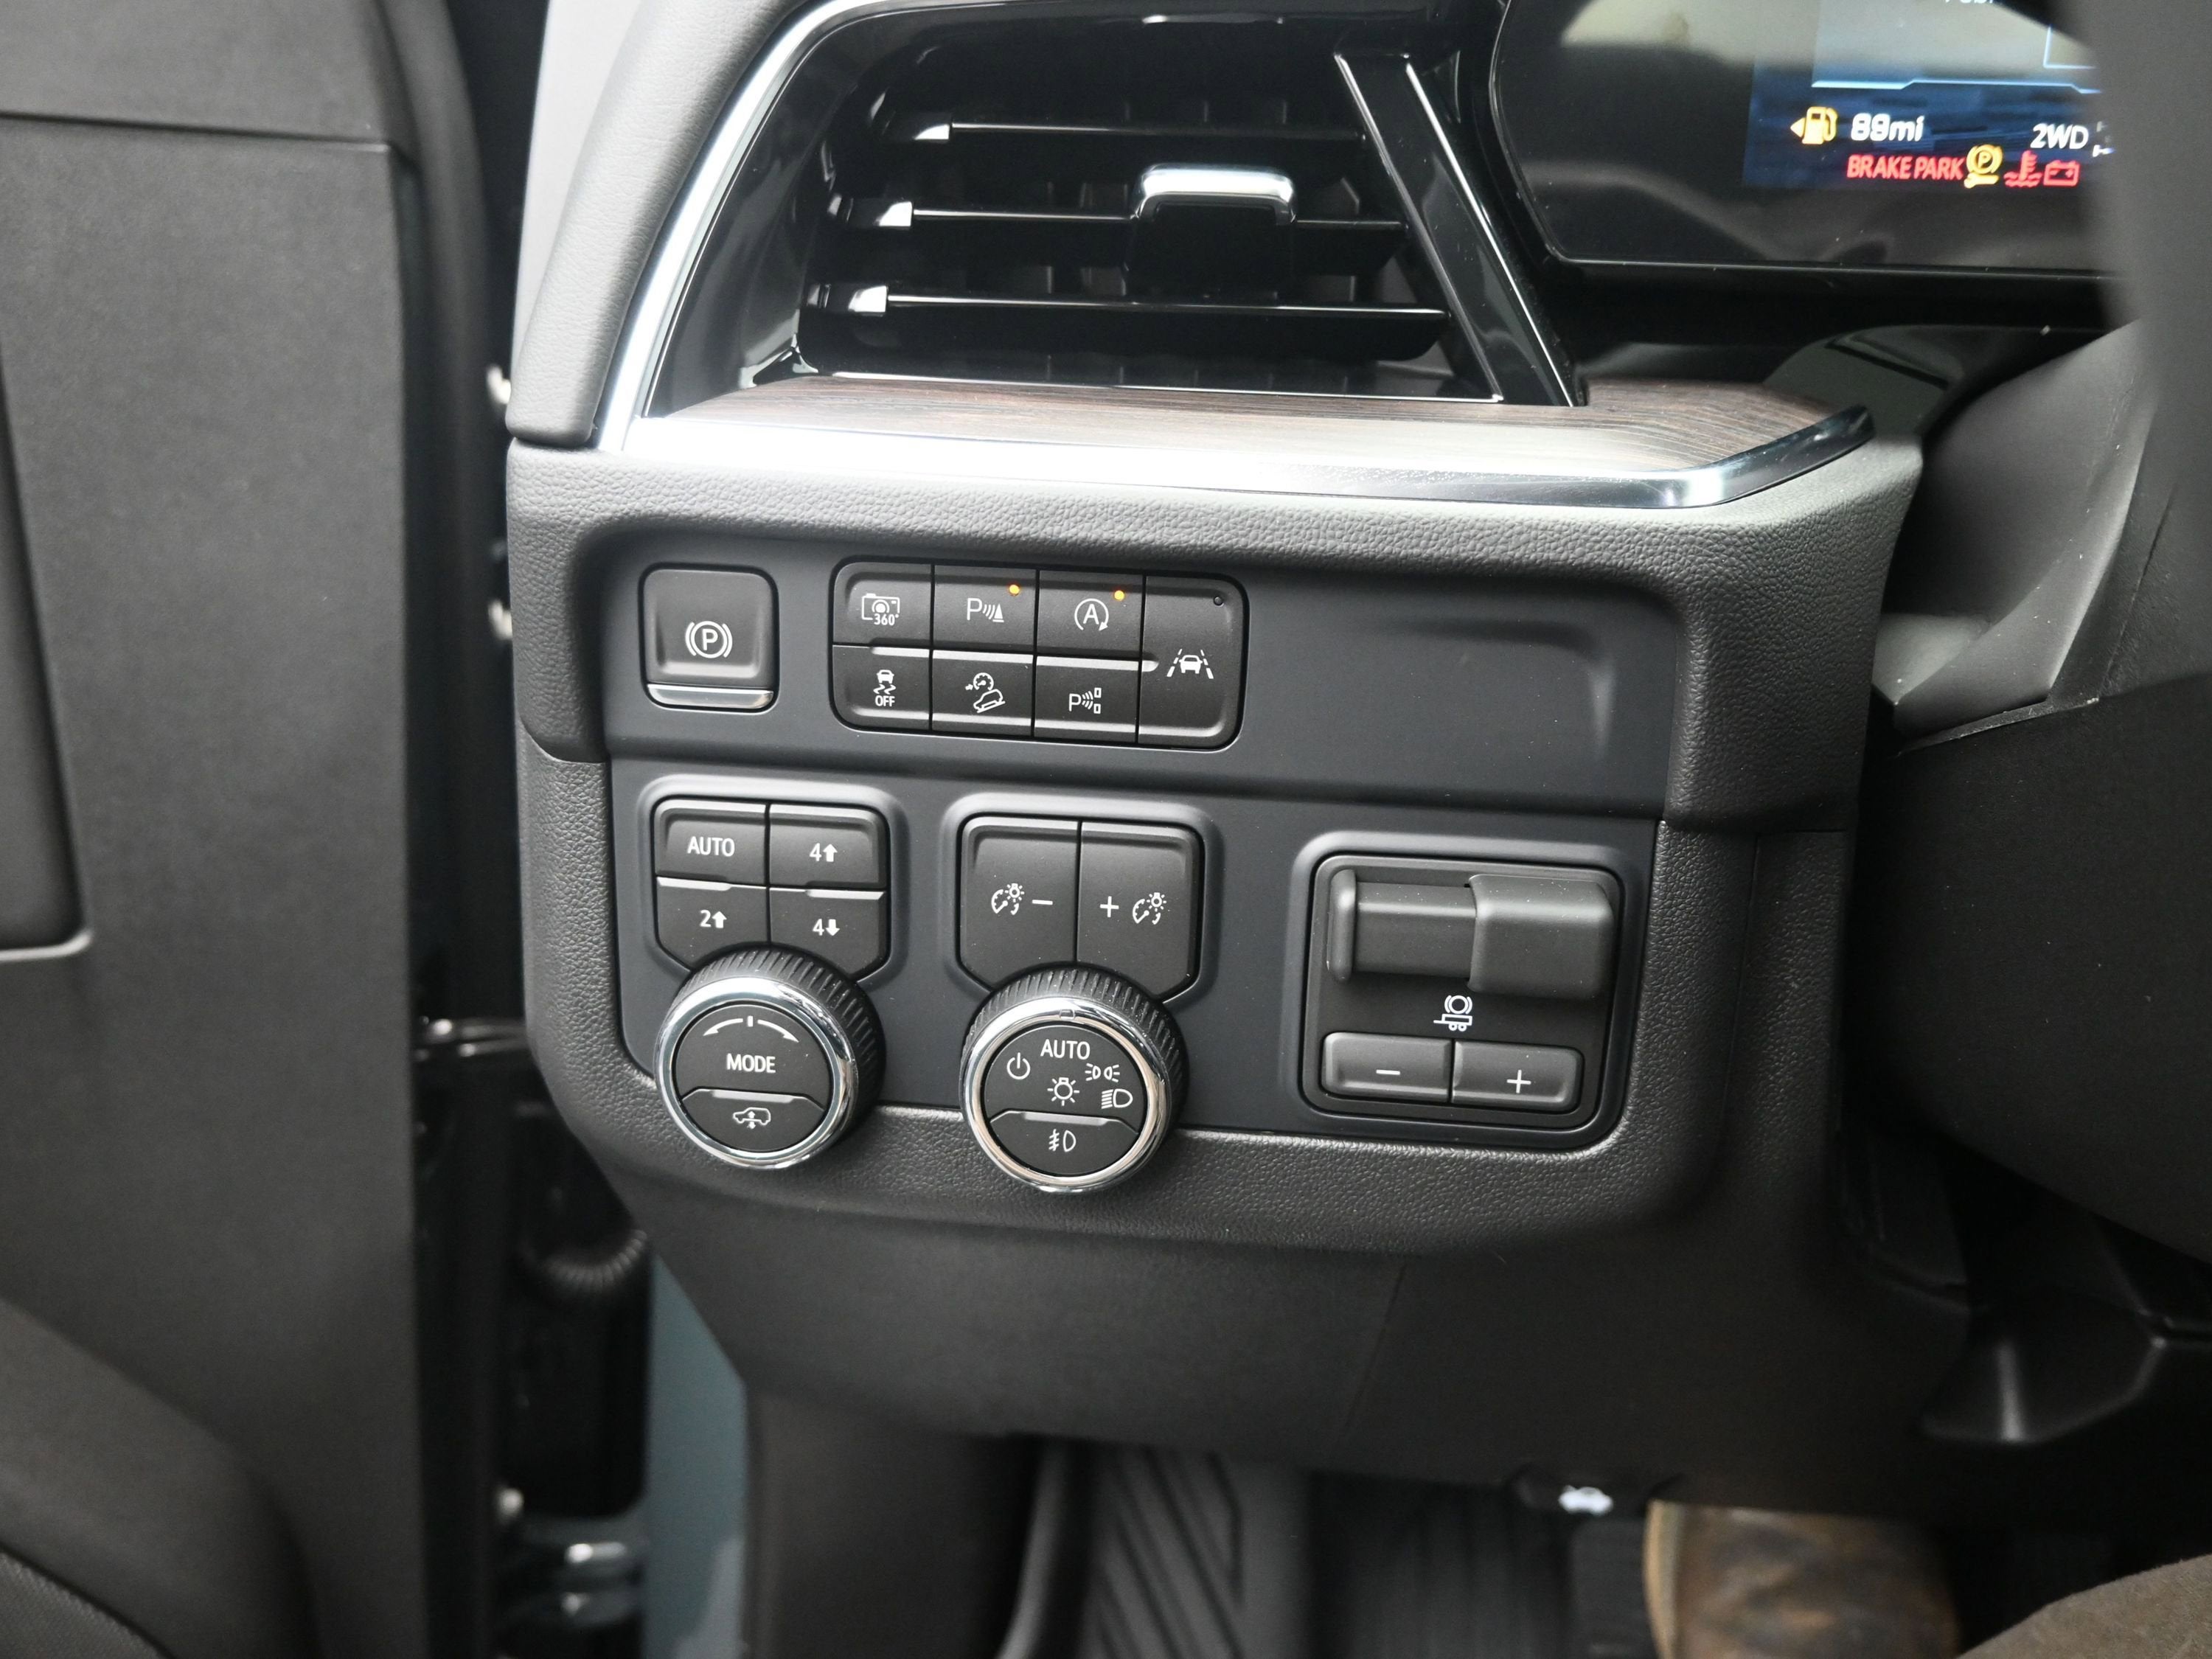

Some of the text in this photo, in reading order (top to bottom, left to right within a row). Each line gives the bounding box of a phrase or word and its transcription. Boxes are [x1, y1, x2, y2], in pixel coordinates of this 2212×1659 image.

[2030, 123, 2090, 149] 2WD
[1847, 154, 1965, 181] BRAKE PARK
[967, 597, 983, 621] P
[1082, 603, 1100, 625] A
[874, 695, 896, 707] OFF
[1068, 693, 1082, 712] P
[686, 835, 736, 857] AUTO
[810, 843, 822, 860] 4
[700, 910, 712, 928] 2
[813, 919, 825, 936] 4
[1040, 1039, 1091, 1060] AUTO
[726, 1053, 776, 1074] MODE
